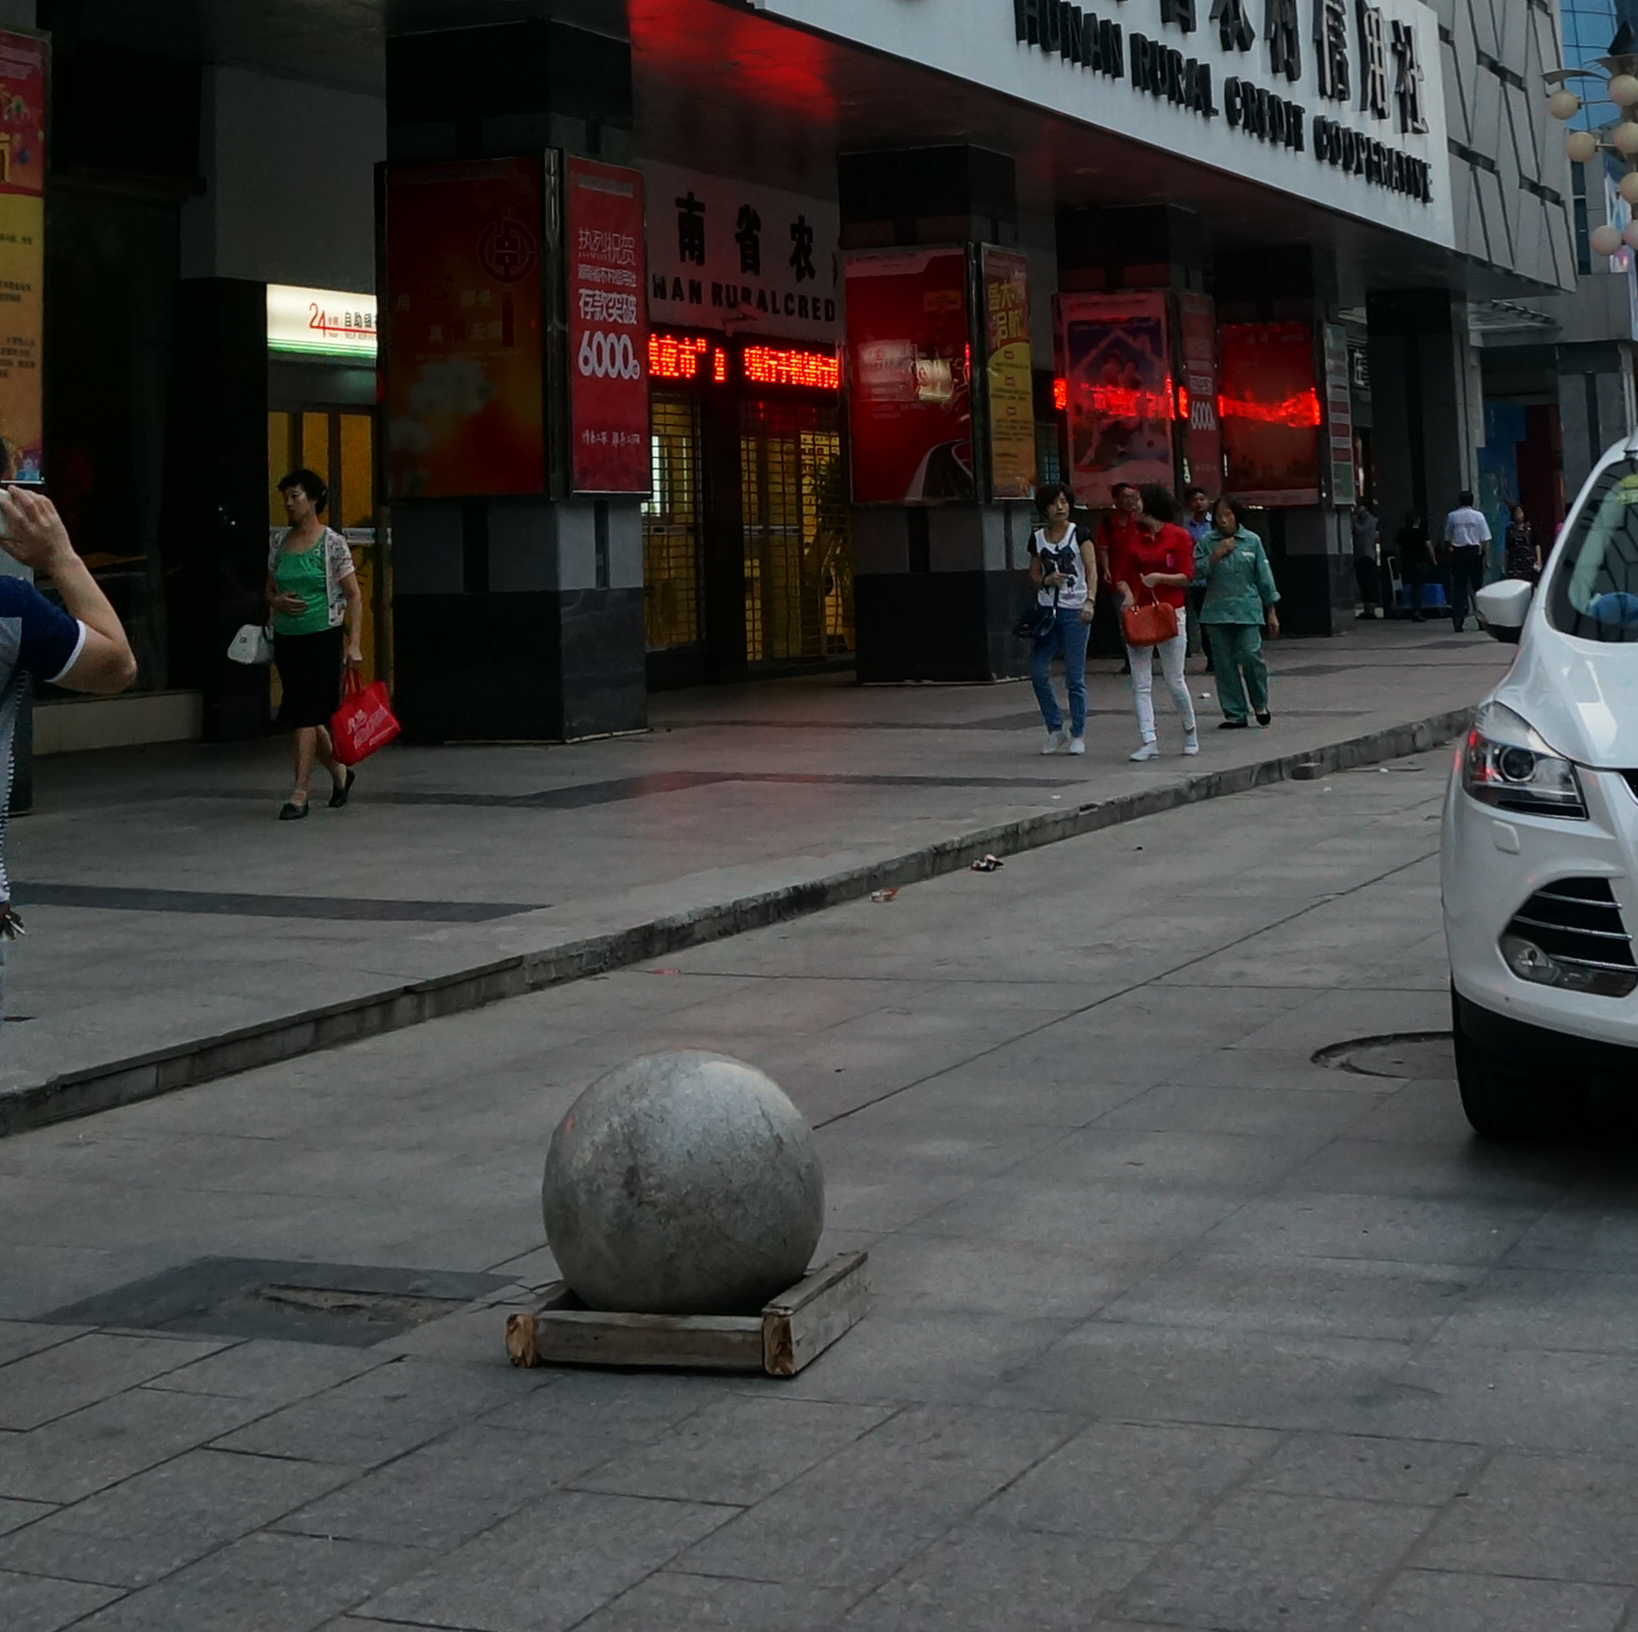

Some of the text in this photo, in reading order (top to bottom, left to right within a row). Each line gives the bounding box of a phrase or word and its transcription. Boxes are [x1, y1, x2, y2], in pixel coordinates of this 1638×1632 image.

[1129, 32, 1219, 118] RURAL
[1224, 75, 1305, 152] CREDIT
[1313, 114, 1434, 204] COOPERATIVE
[676, 192, 838, 286] 南省农
[309, 302, 326, 338] 24
[344, 311, 377, 328] 自助银
[578, 288, 637, 325] 存款突破
